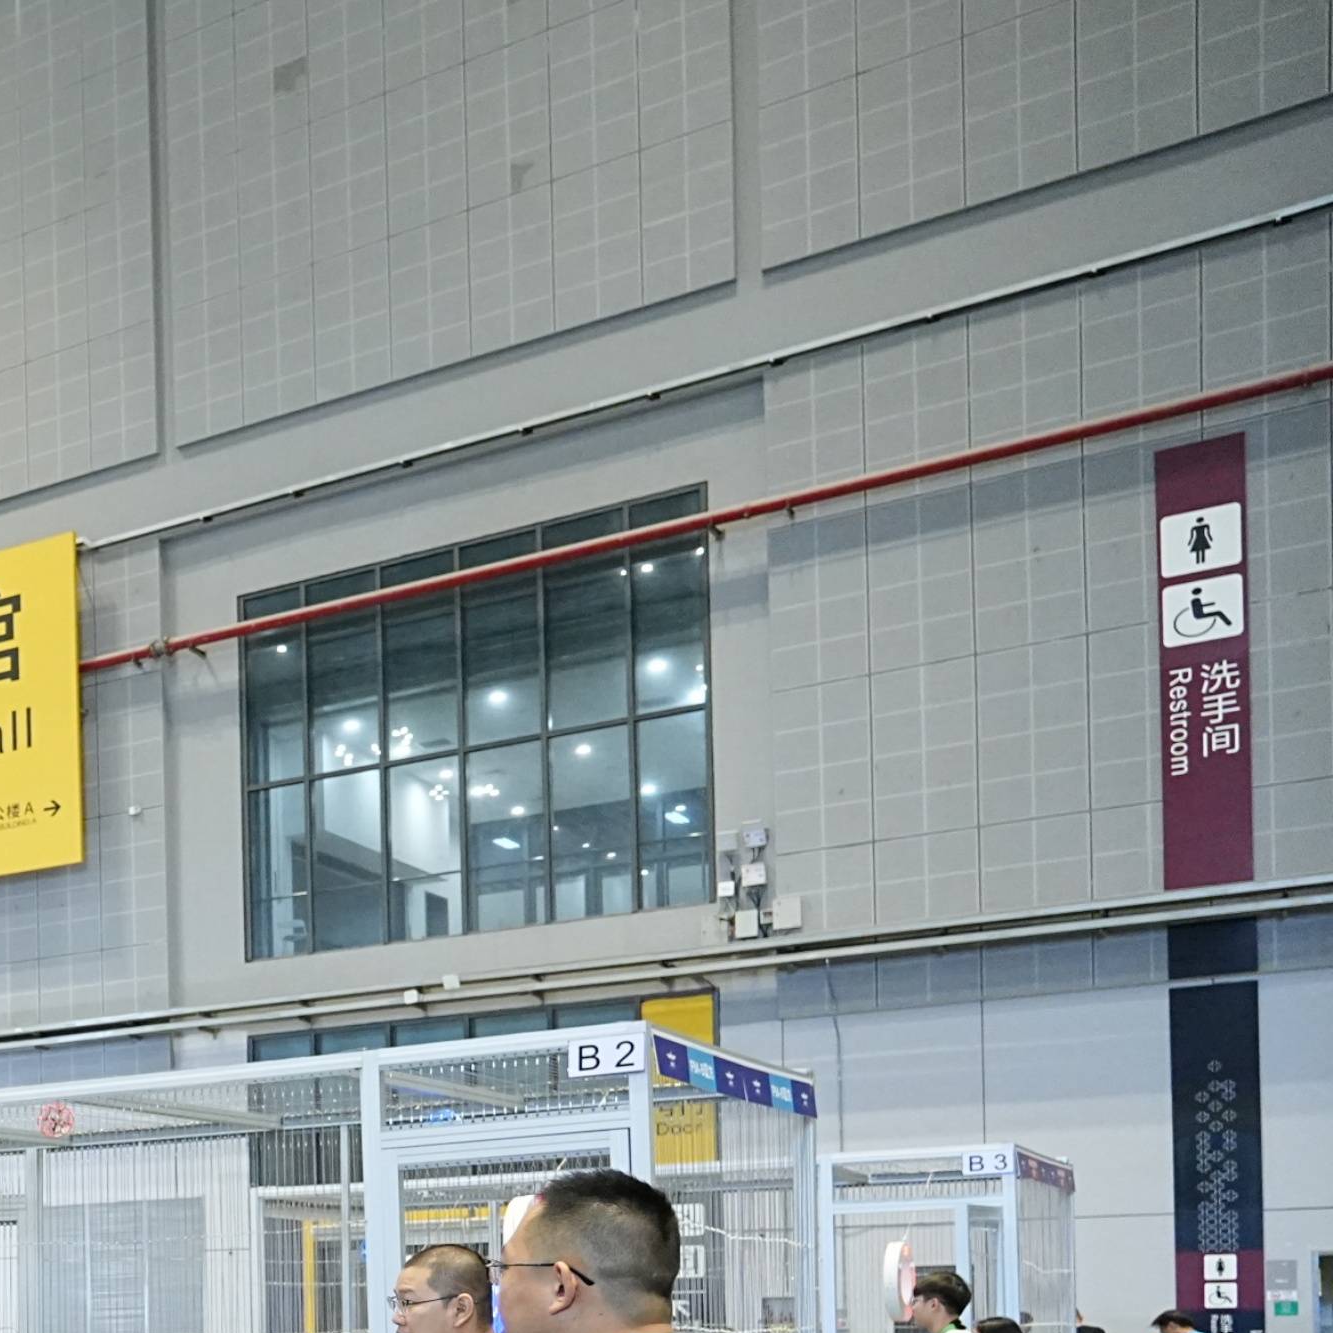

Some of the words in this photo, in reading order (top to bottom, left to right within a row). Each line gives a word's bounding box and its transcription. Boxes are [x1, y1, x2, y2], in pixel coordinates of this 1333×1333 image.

[1169, 667, 1193, 776] Restroom
[1200, 659, 1241, 758] 洗手间
[24, 801, 34, 815] A
[578, 1043, 601, 1072] B
[614, 1040, 635, 1068] 2
[969, 1155, 985, 1172] B
[994, 1153, 1008, 1170] 3
